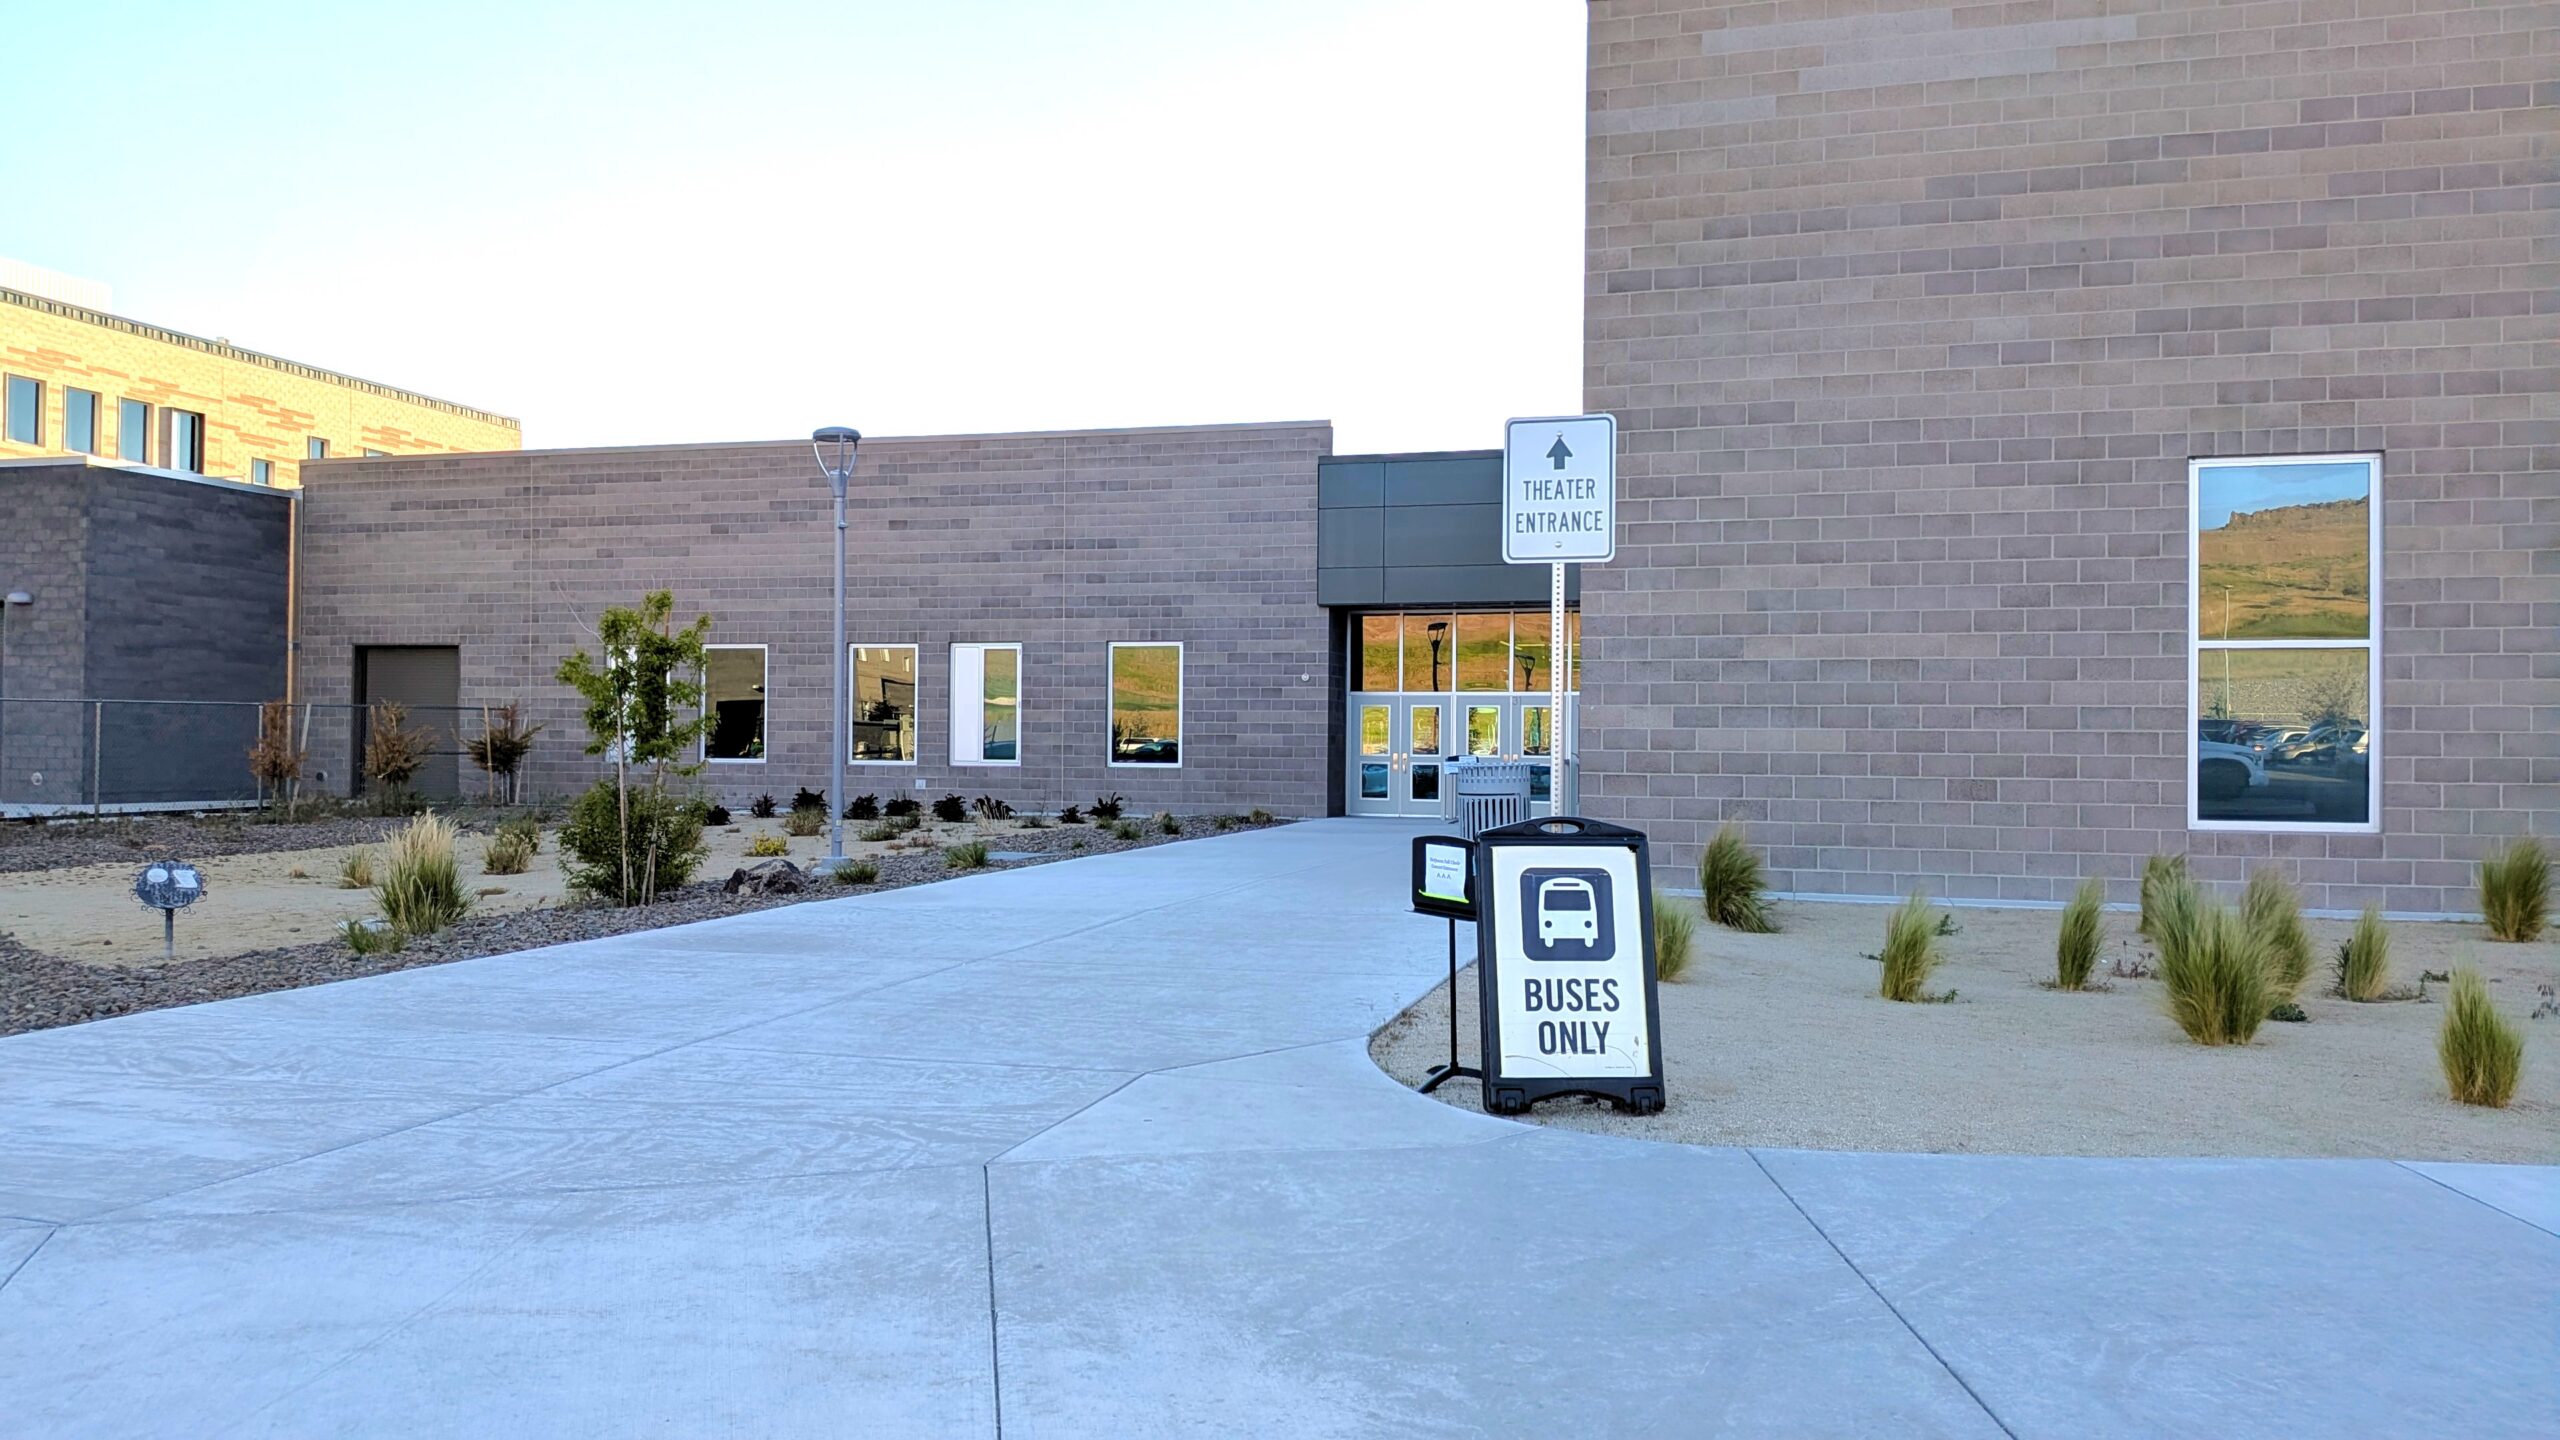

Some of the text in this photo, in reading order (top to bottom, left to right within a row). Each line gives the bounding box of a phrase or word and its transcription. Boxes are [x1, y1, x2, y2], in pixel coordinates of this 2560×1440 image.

[1523, 478, 1596, 501] THEATER
[1515, 510, 1604, 534] ENTRANCE
[1524, 978, 1620, 1013] BUSES
[1538, 1020, 1611, 1055] ONLY
